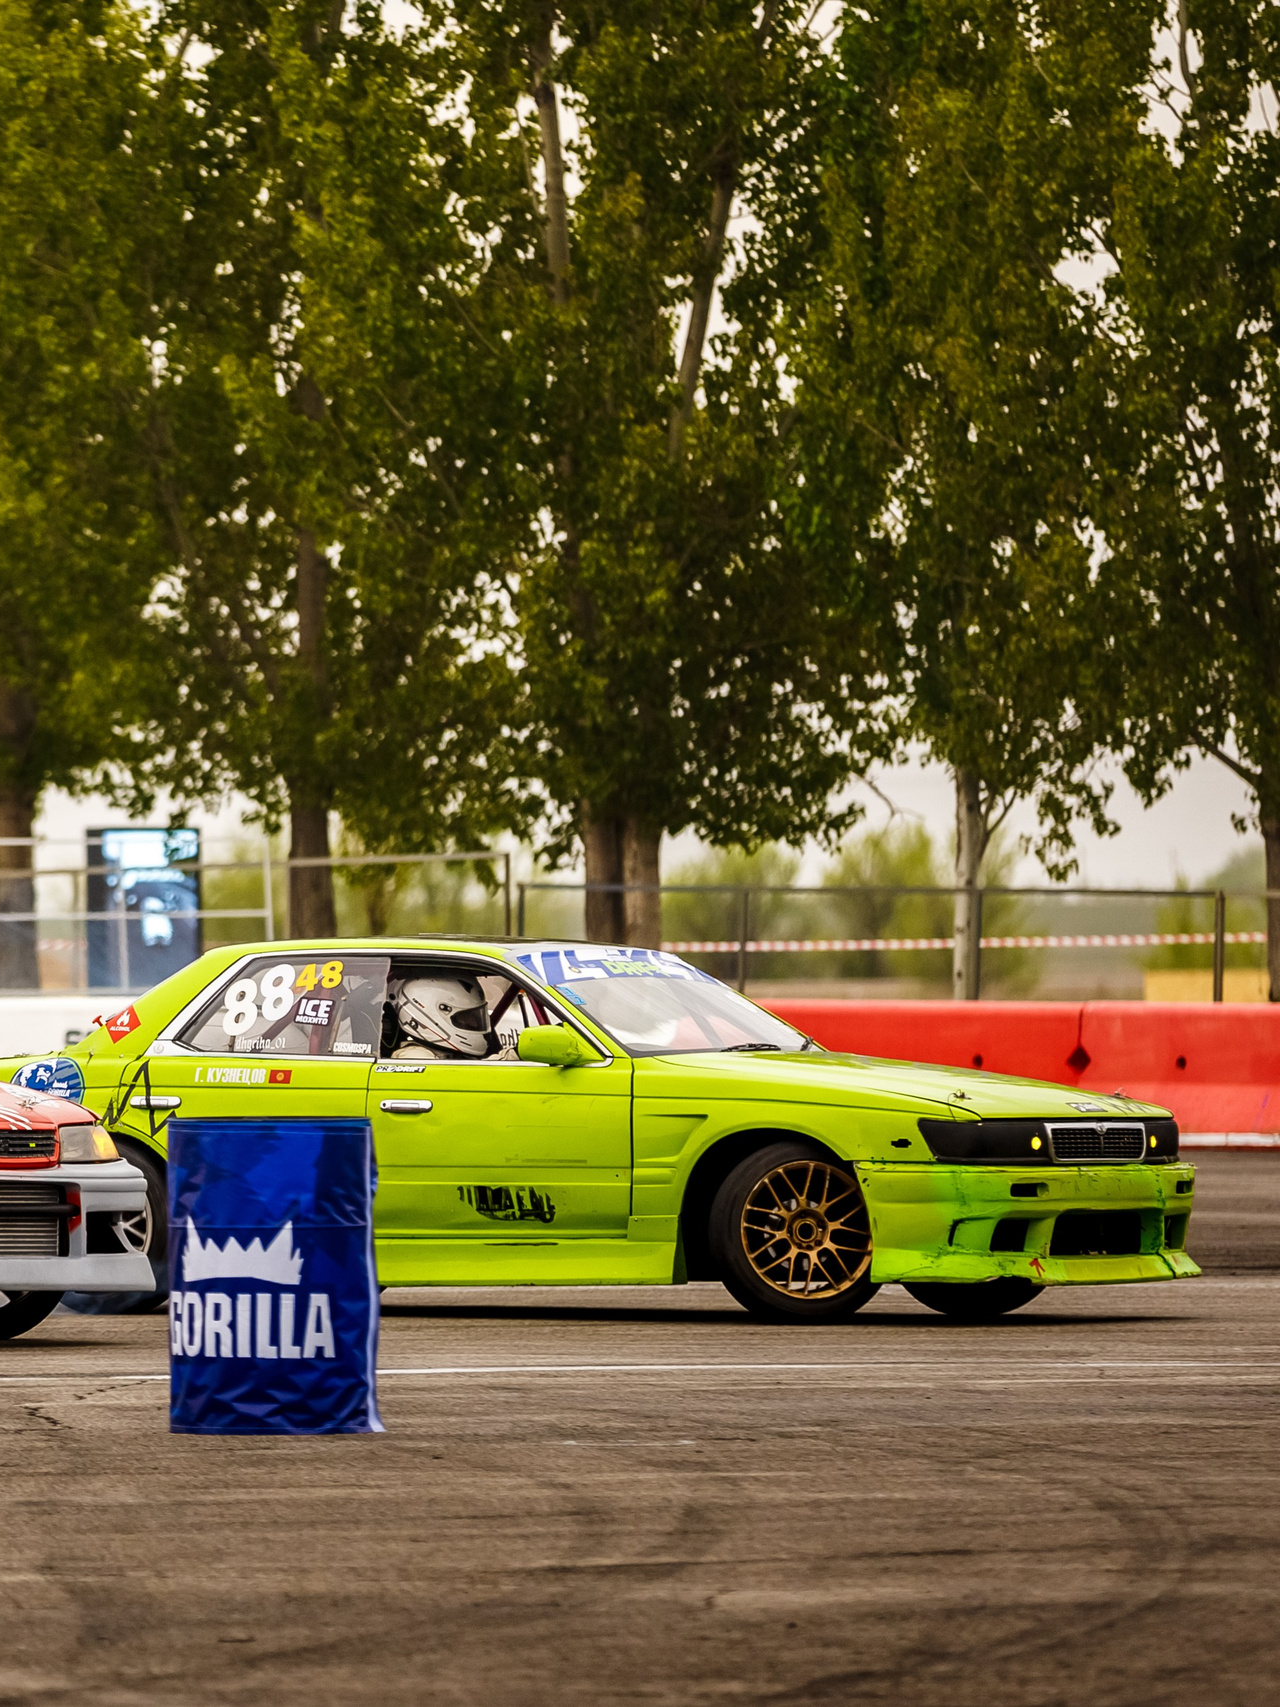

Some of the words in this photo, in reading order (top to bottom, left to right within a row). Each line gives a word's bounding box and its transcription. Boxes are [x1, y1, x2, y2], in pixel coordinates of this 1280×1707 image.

[296, 960, 344, 991] 48
[600, 960, 673, 977] DRIFT
[222, 963, 296, 1036] 88
[298, 998, 333, 1018] ICE
[206, 1067, 267, 1086] КУЗНЕЦОВ
[170, 1291, 336, 1359] GORILLA
